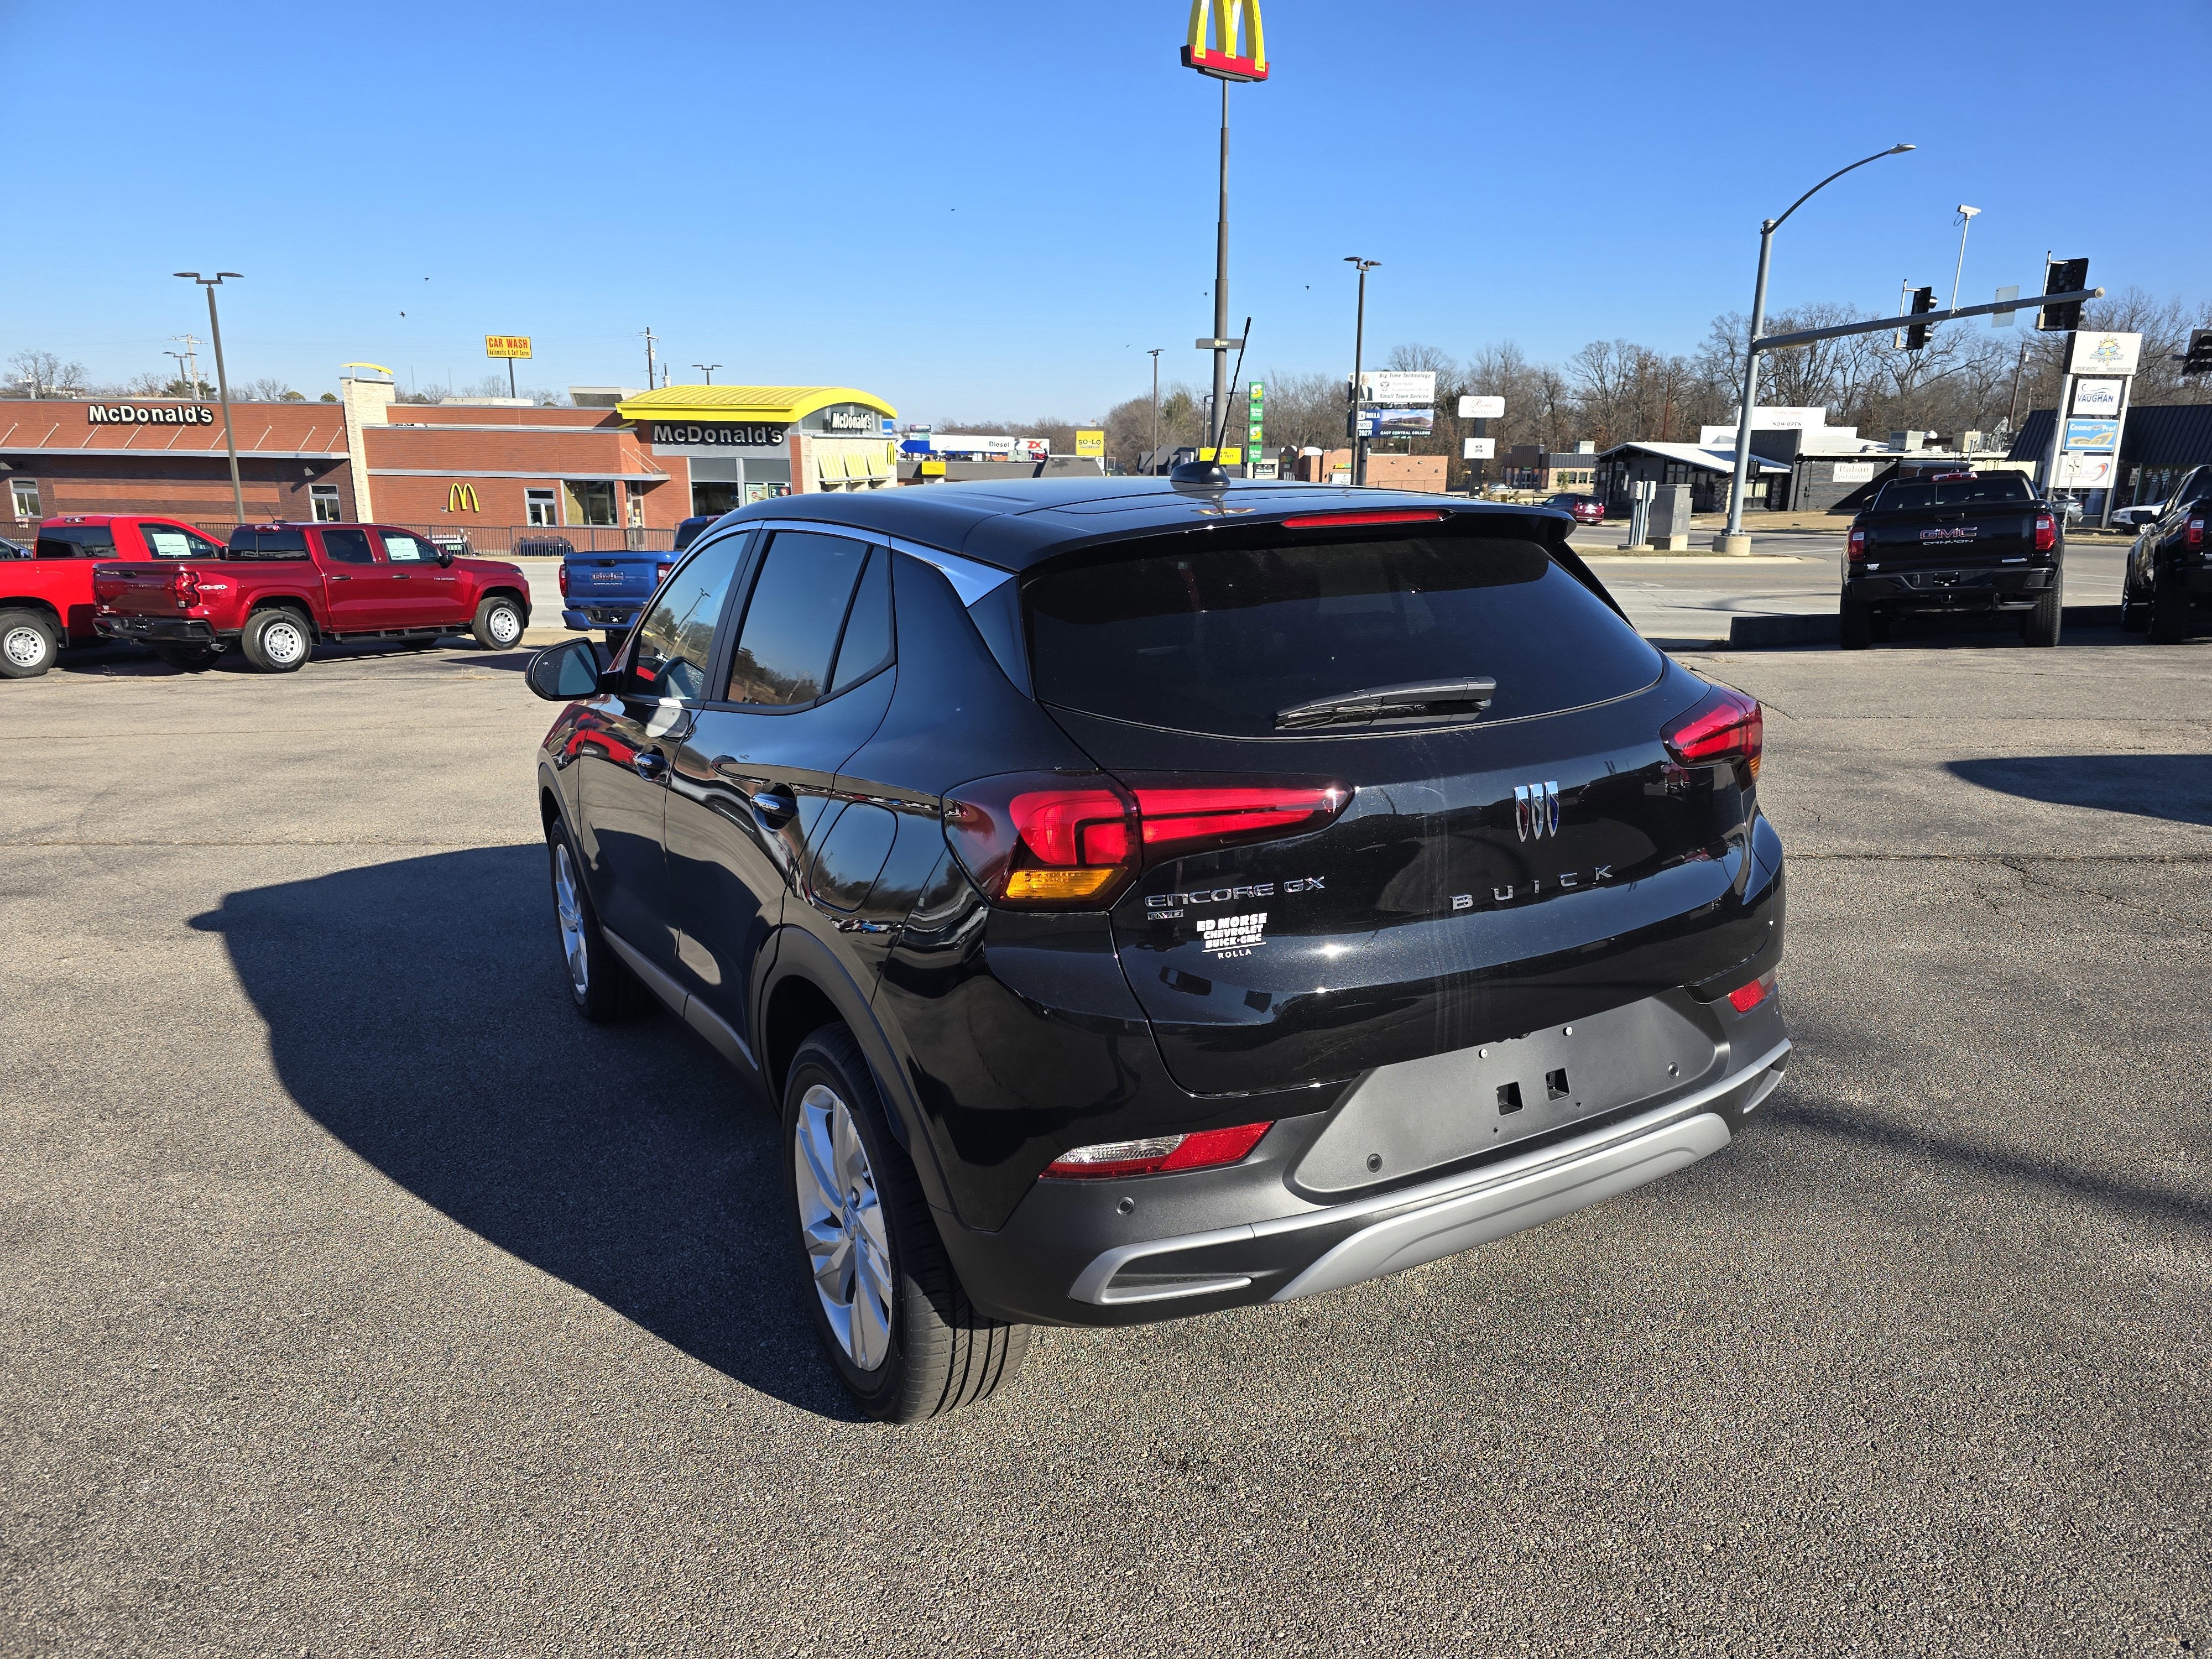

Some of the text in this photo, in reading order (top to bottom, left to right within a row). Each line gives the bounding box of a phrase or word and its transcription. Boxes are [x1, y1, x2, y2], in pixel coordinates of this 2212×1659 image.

[489, 338, 528, 349] CAR WASH
[2078, 393, 2114, 403] VAUGHAN
[89, 405, 213, 423] McDonald's
[832, 413, 872, 429] McDonald's
[654, 425, 784, 444] McDonald's
[1919, 526, 1978, 540] GMC
[1144, 876, 1326, 907] ENCORE GX
[1449, 865, 1613, 911] BUICK
[1196, 912, 1268, 932] ED MORSE
[1203, 924, 1264, 940] CHEVROLET
[1218, 948, 1252, 959] ROLLA
